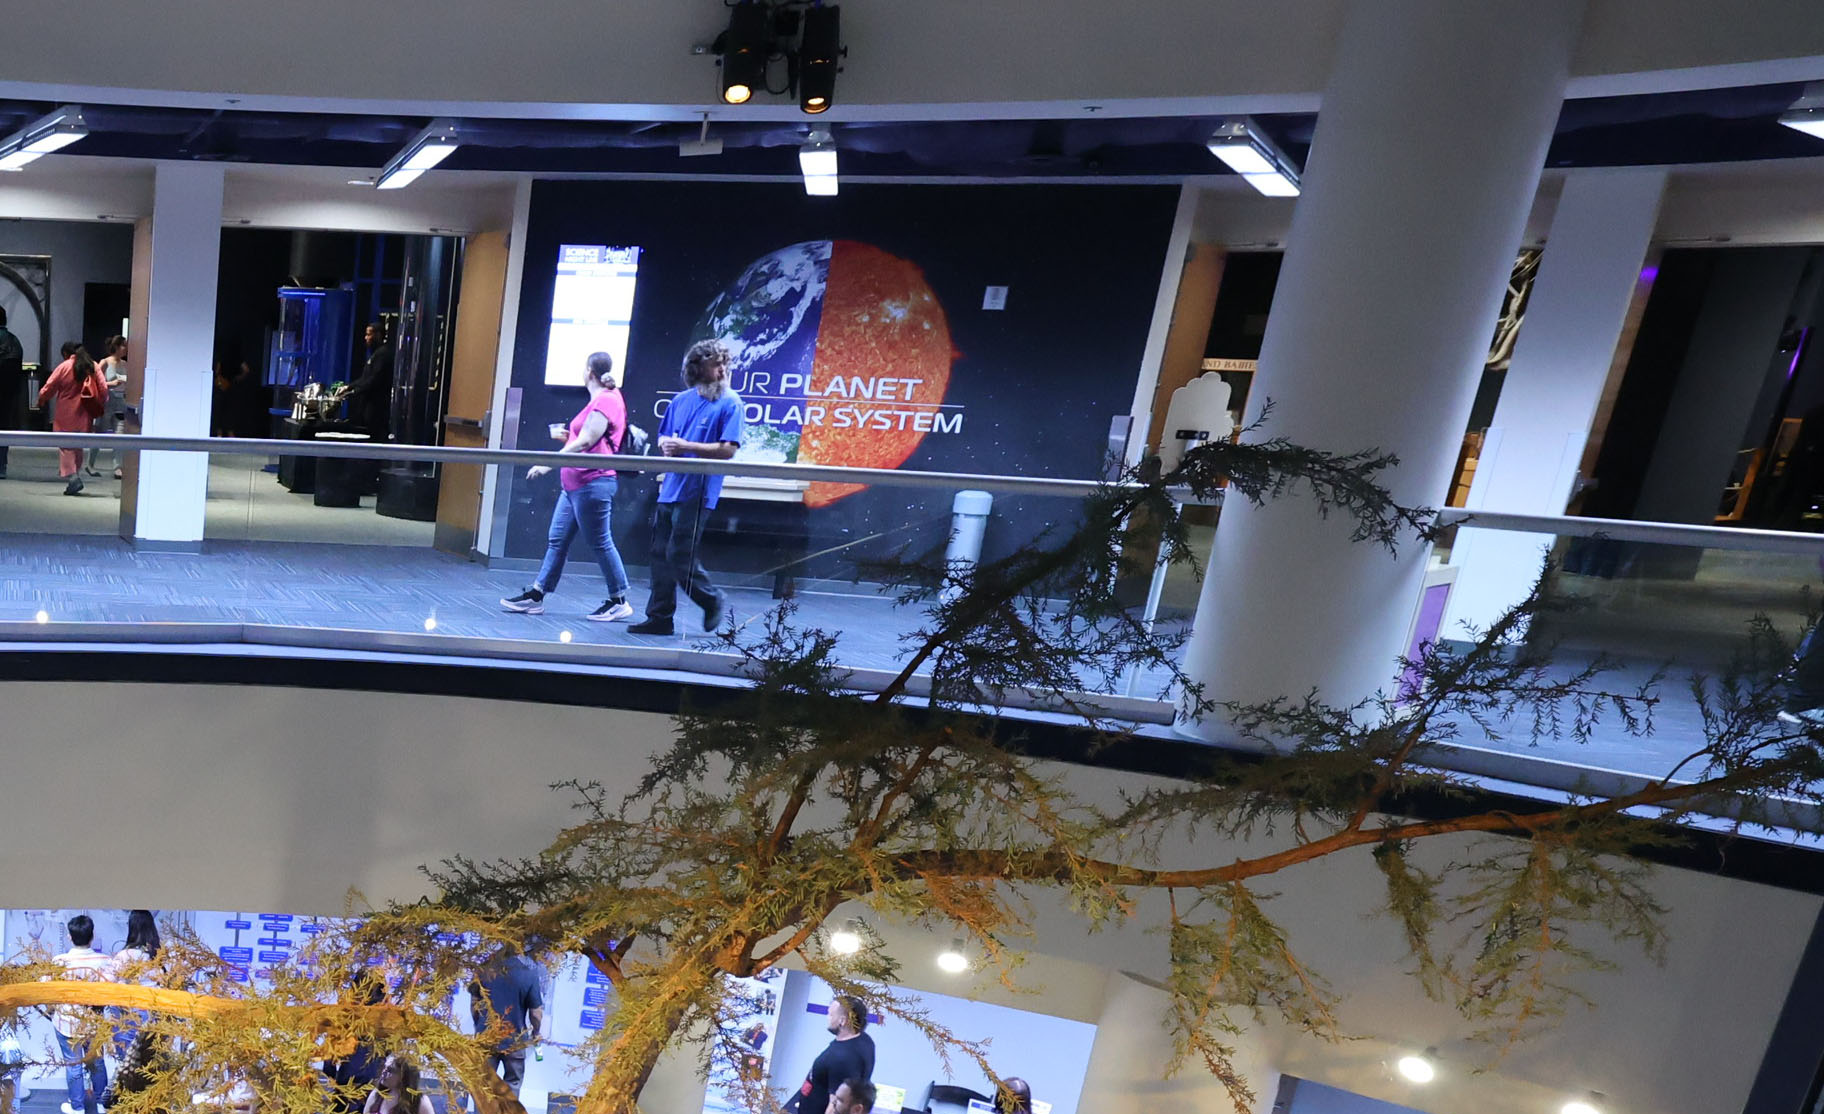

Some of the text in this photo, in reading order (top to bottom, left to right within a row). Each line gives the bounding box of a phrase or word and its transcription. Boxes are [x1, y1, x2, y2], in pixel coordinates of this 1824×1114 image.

[728, 371, 924, 401] UR PLANET
[743, 403, 964, 434] OLAR SYSTEM
